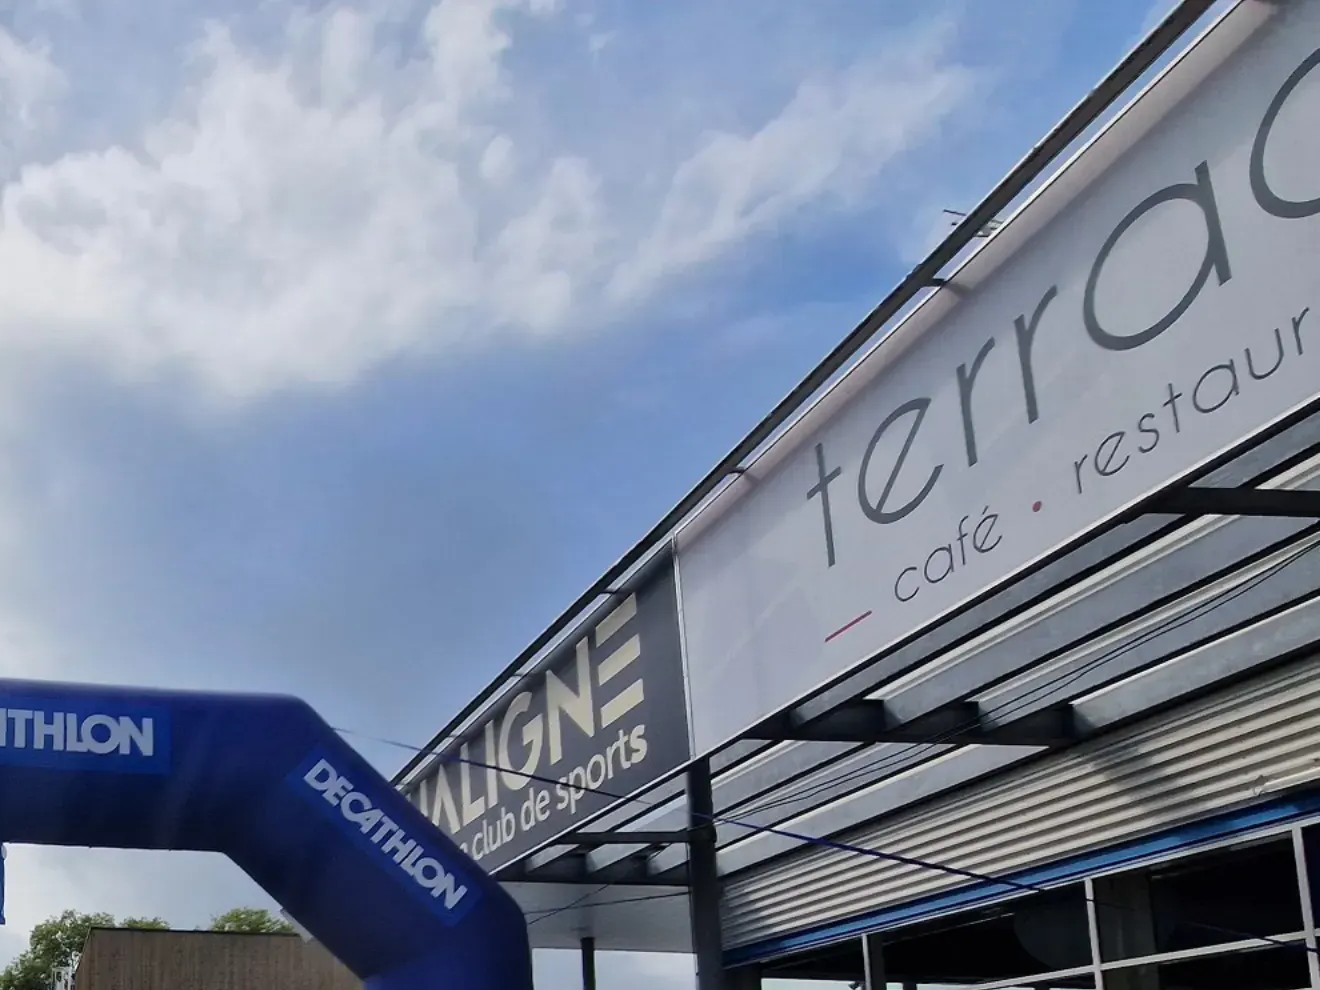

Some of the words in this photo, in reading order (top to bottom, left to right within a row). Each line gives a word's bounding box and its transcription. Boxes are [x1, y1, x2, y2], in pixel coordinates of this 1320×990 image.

[893, 505, 1003, 602] café
[1074, 307, 1310, 494] restaur
[303, 758, 468, 911] DECATHLON
[472, 806, 516, 861] club
[520, 786, 551, 829] de
[555, 723, 648, 815] sports
